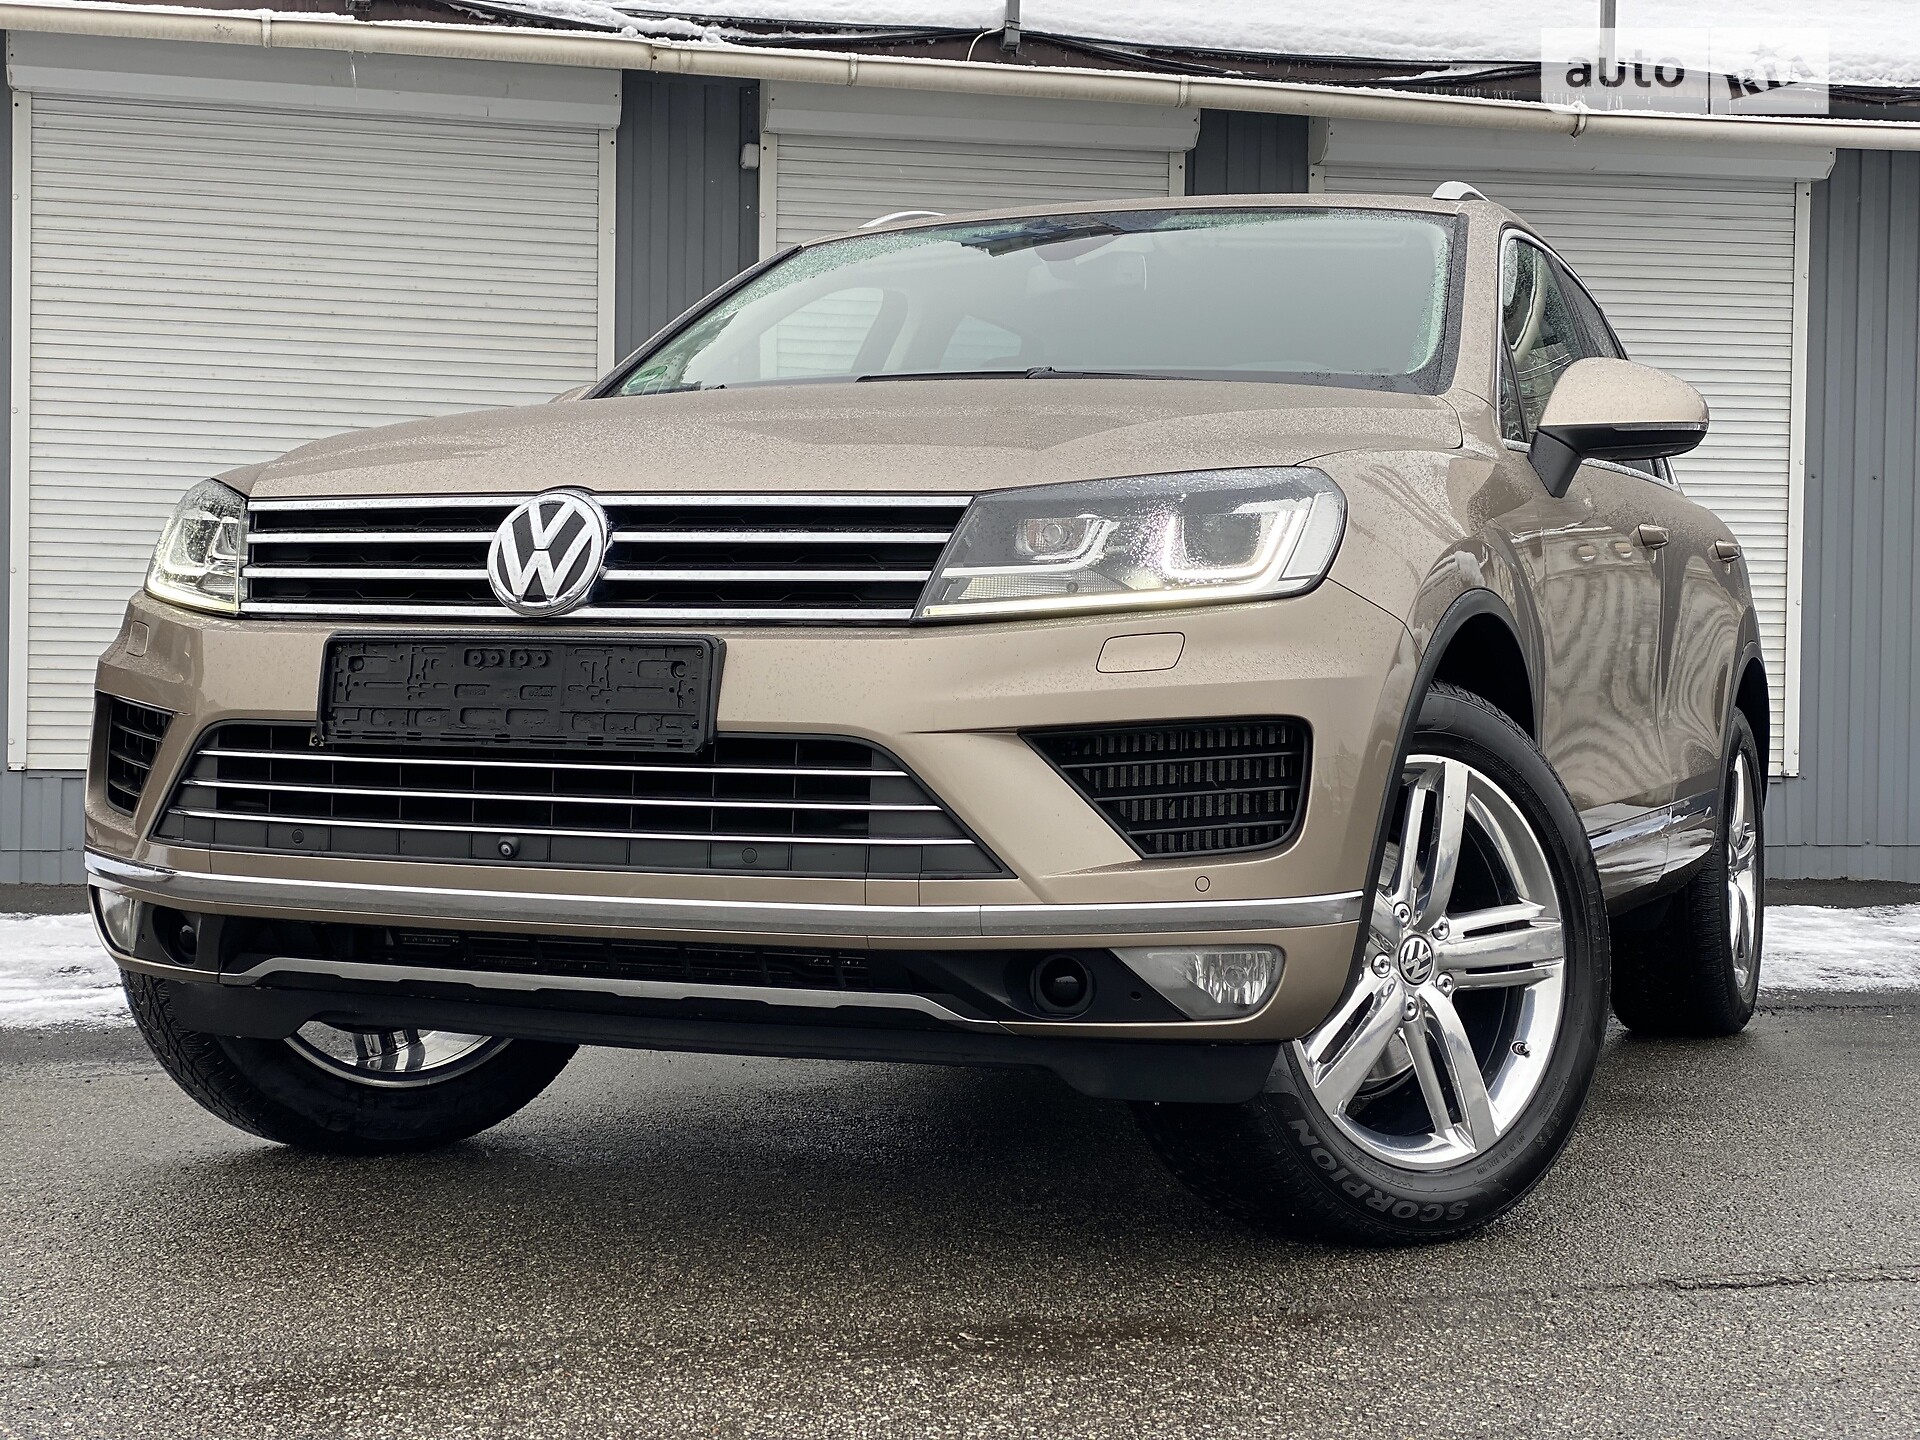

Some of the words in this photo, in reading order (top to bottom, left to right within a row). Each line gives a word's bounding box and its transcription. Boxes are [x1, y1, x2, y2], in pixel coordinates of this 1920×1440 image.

[494, 496, 599, 606] VW
[1400, 936, 1433, 983] VW
[1287, 1119, 1469, 1222] SCORPION
